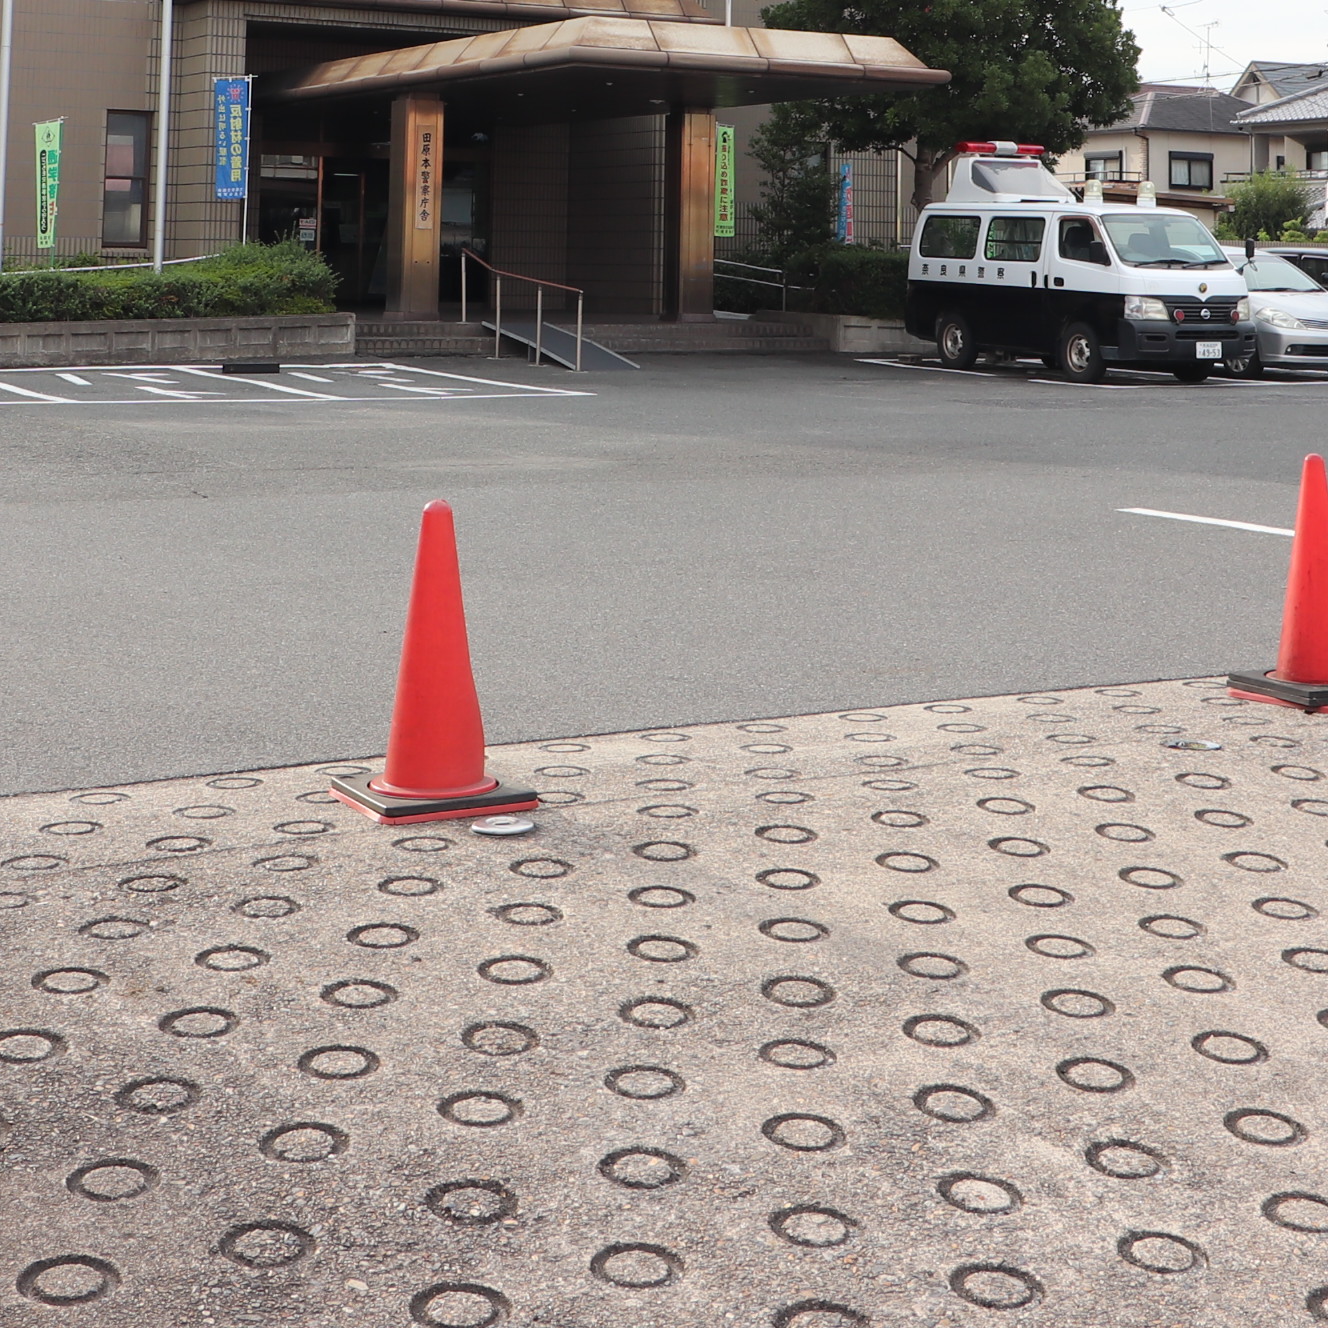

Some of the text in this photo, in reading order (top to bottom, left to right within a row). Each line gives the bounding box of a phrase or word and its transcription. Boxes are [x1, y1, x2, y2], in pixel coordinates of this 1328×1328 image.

[419, 132, 432, 221] 田原本警察庁舎
[921, 263, 1006, 280] 奈良県警察
